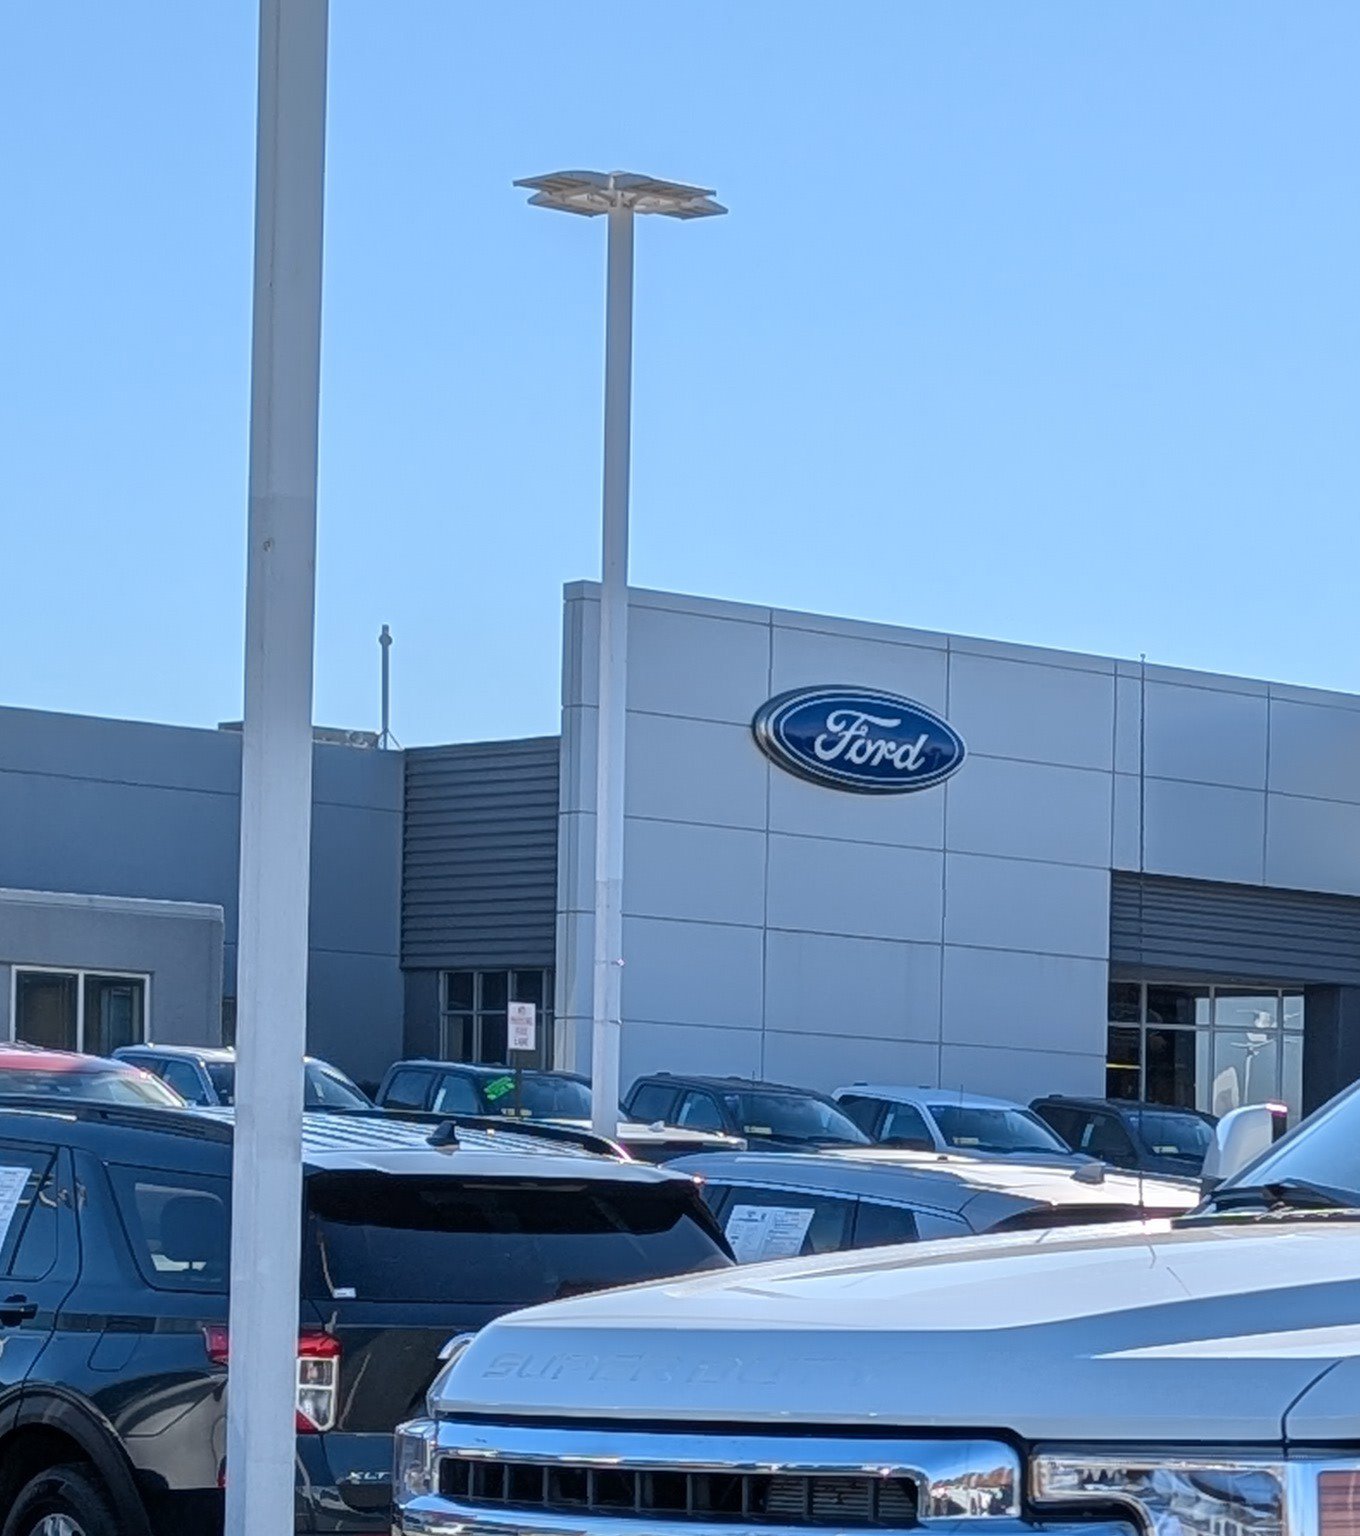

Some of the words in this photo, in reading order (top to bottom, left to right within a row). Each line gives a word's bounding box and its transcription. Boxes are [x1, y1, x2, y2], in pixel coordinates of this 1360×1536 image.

[814, 709, 929, 771] Ford
[480, 1350, 680, 1384] SUPER
[346, 1471, 391, 1480] XLT
